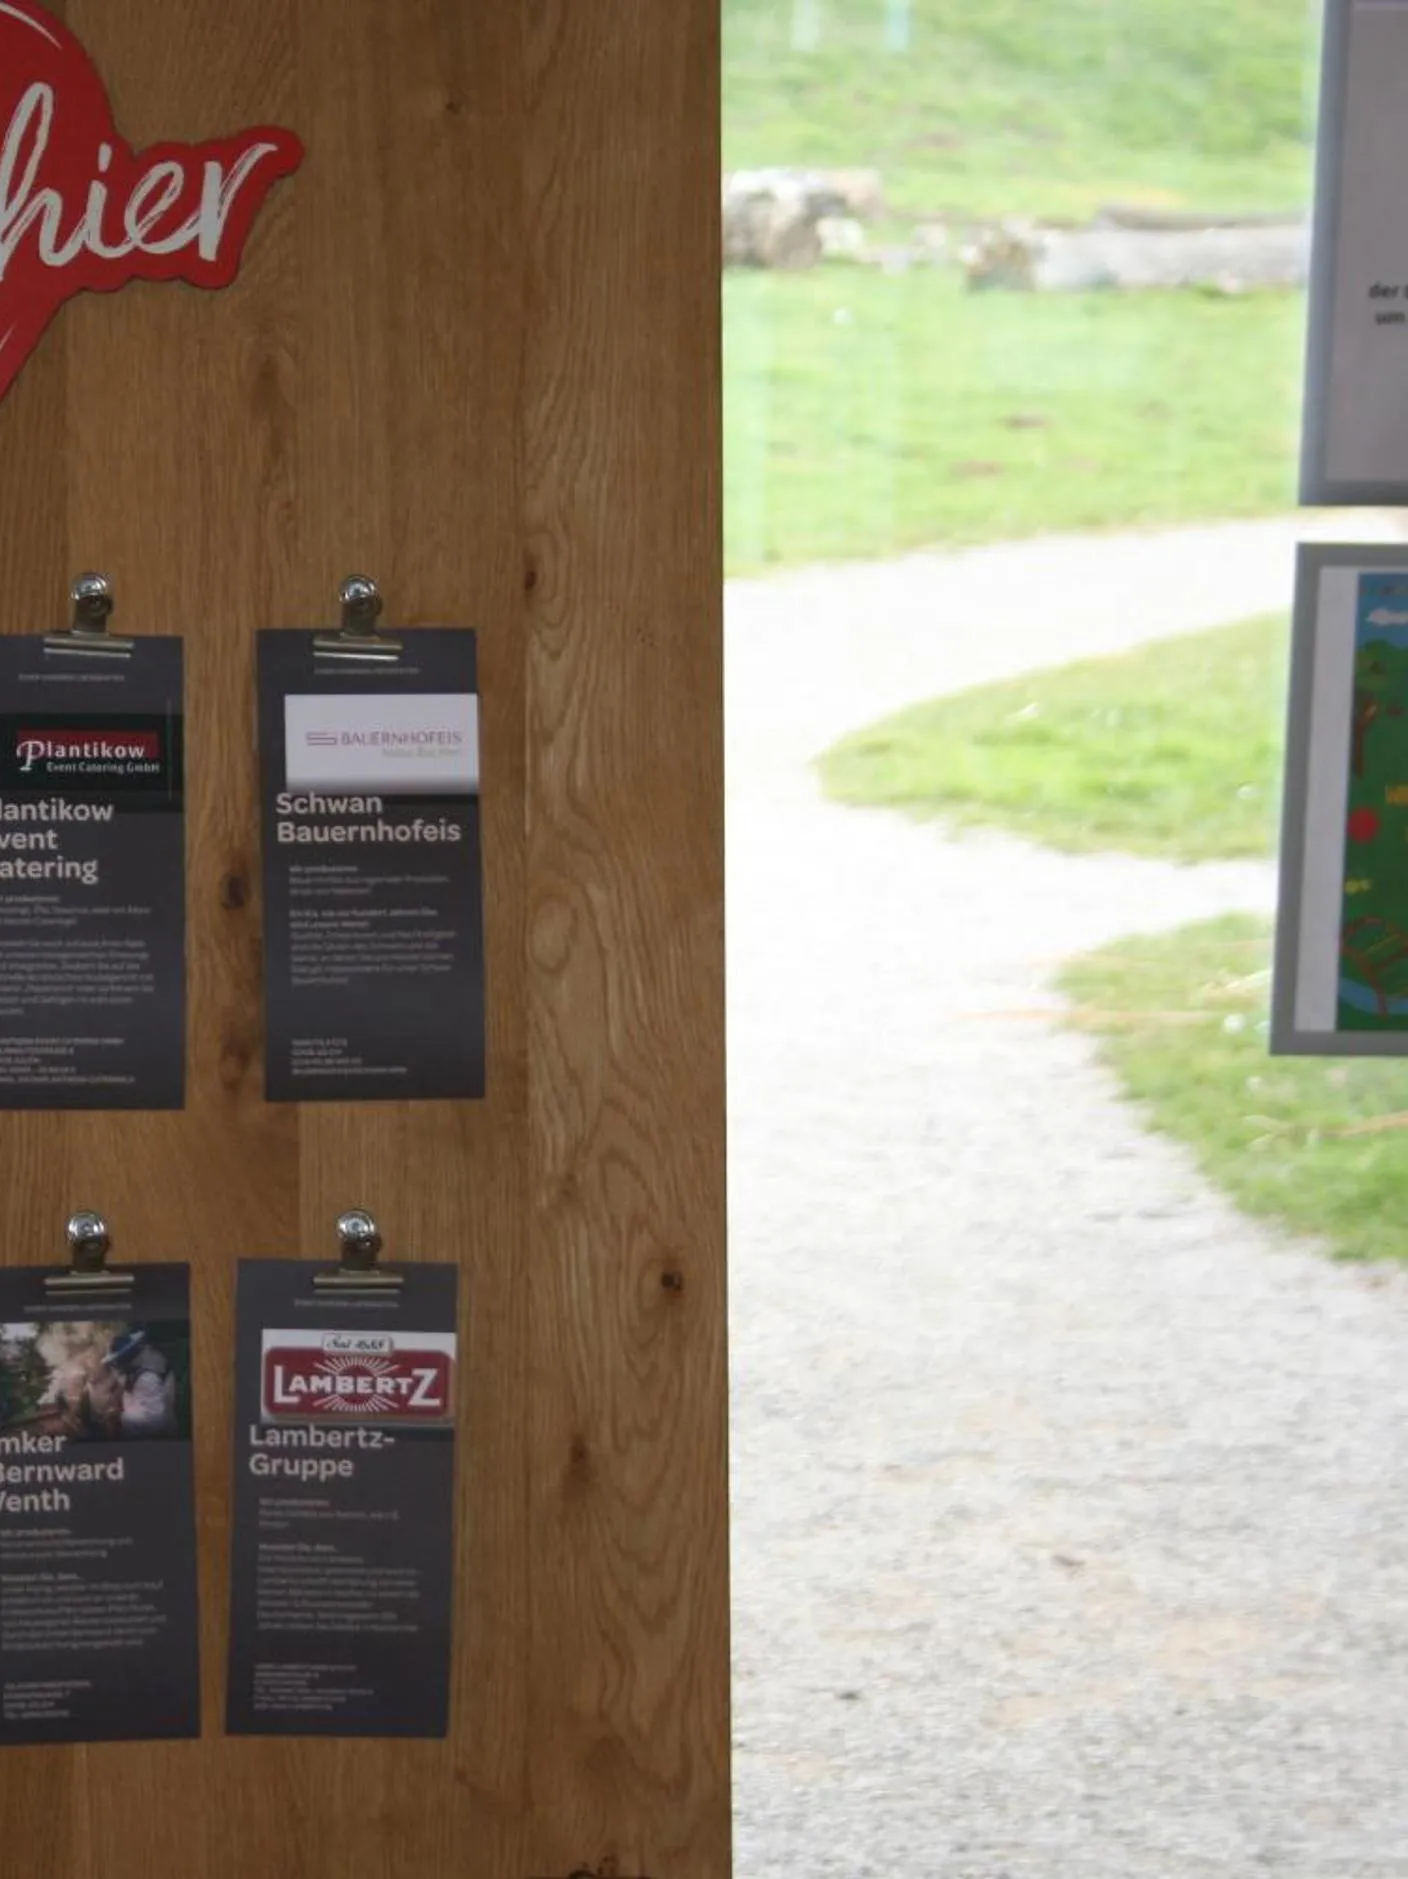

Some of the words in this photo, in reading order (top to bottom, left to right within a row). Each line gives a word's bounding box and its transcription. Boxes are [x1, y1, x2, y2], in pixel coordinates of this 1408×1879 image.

[16, 740, 145, 772] Plantikow
[46, 762, 77, 772] Event
[276, 792, 383, 816] Schwan
[277, 818, 462, 843] Bauernhofeis
[273, 1365, 441, 1407] LAMBERTZ
[249, 1425, 395, 1449] Lambertz-
[249, 1454, 355, 1482] Gruppe
